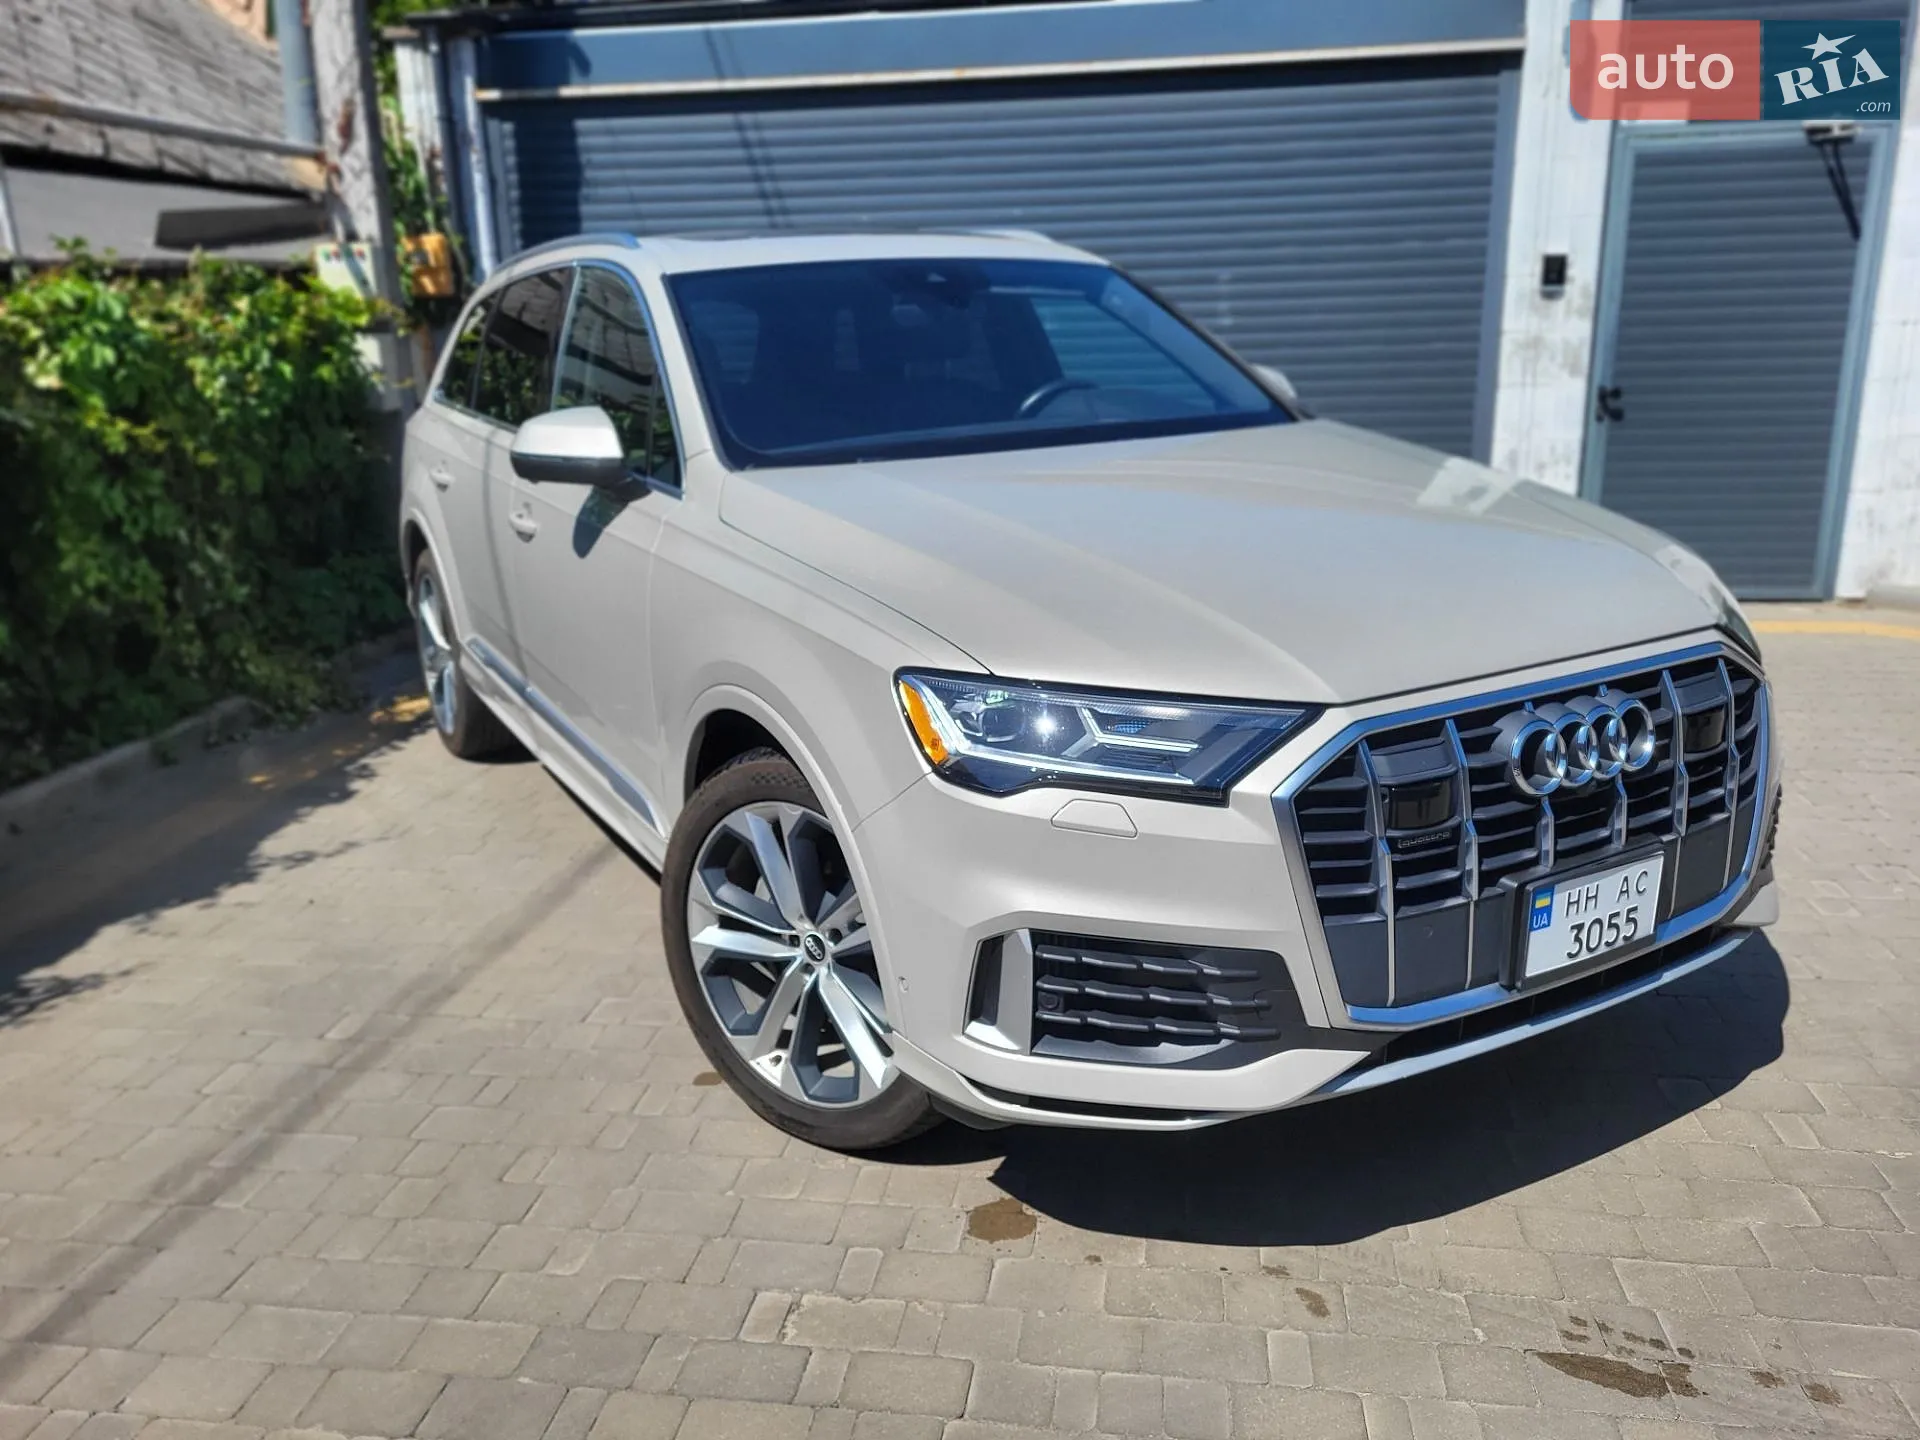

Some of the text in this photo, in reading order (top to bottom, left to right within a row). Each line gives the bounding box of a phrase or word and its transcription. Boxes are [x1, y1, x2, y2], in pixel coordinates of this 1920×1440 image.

[1565, 870, 1648, 917] HH AC
[1532, 913, 1549, 928] UA
[1566, 906, 1639, 959] 3055
